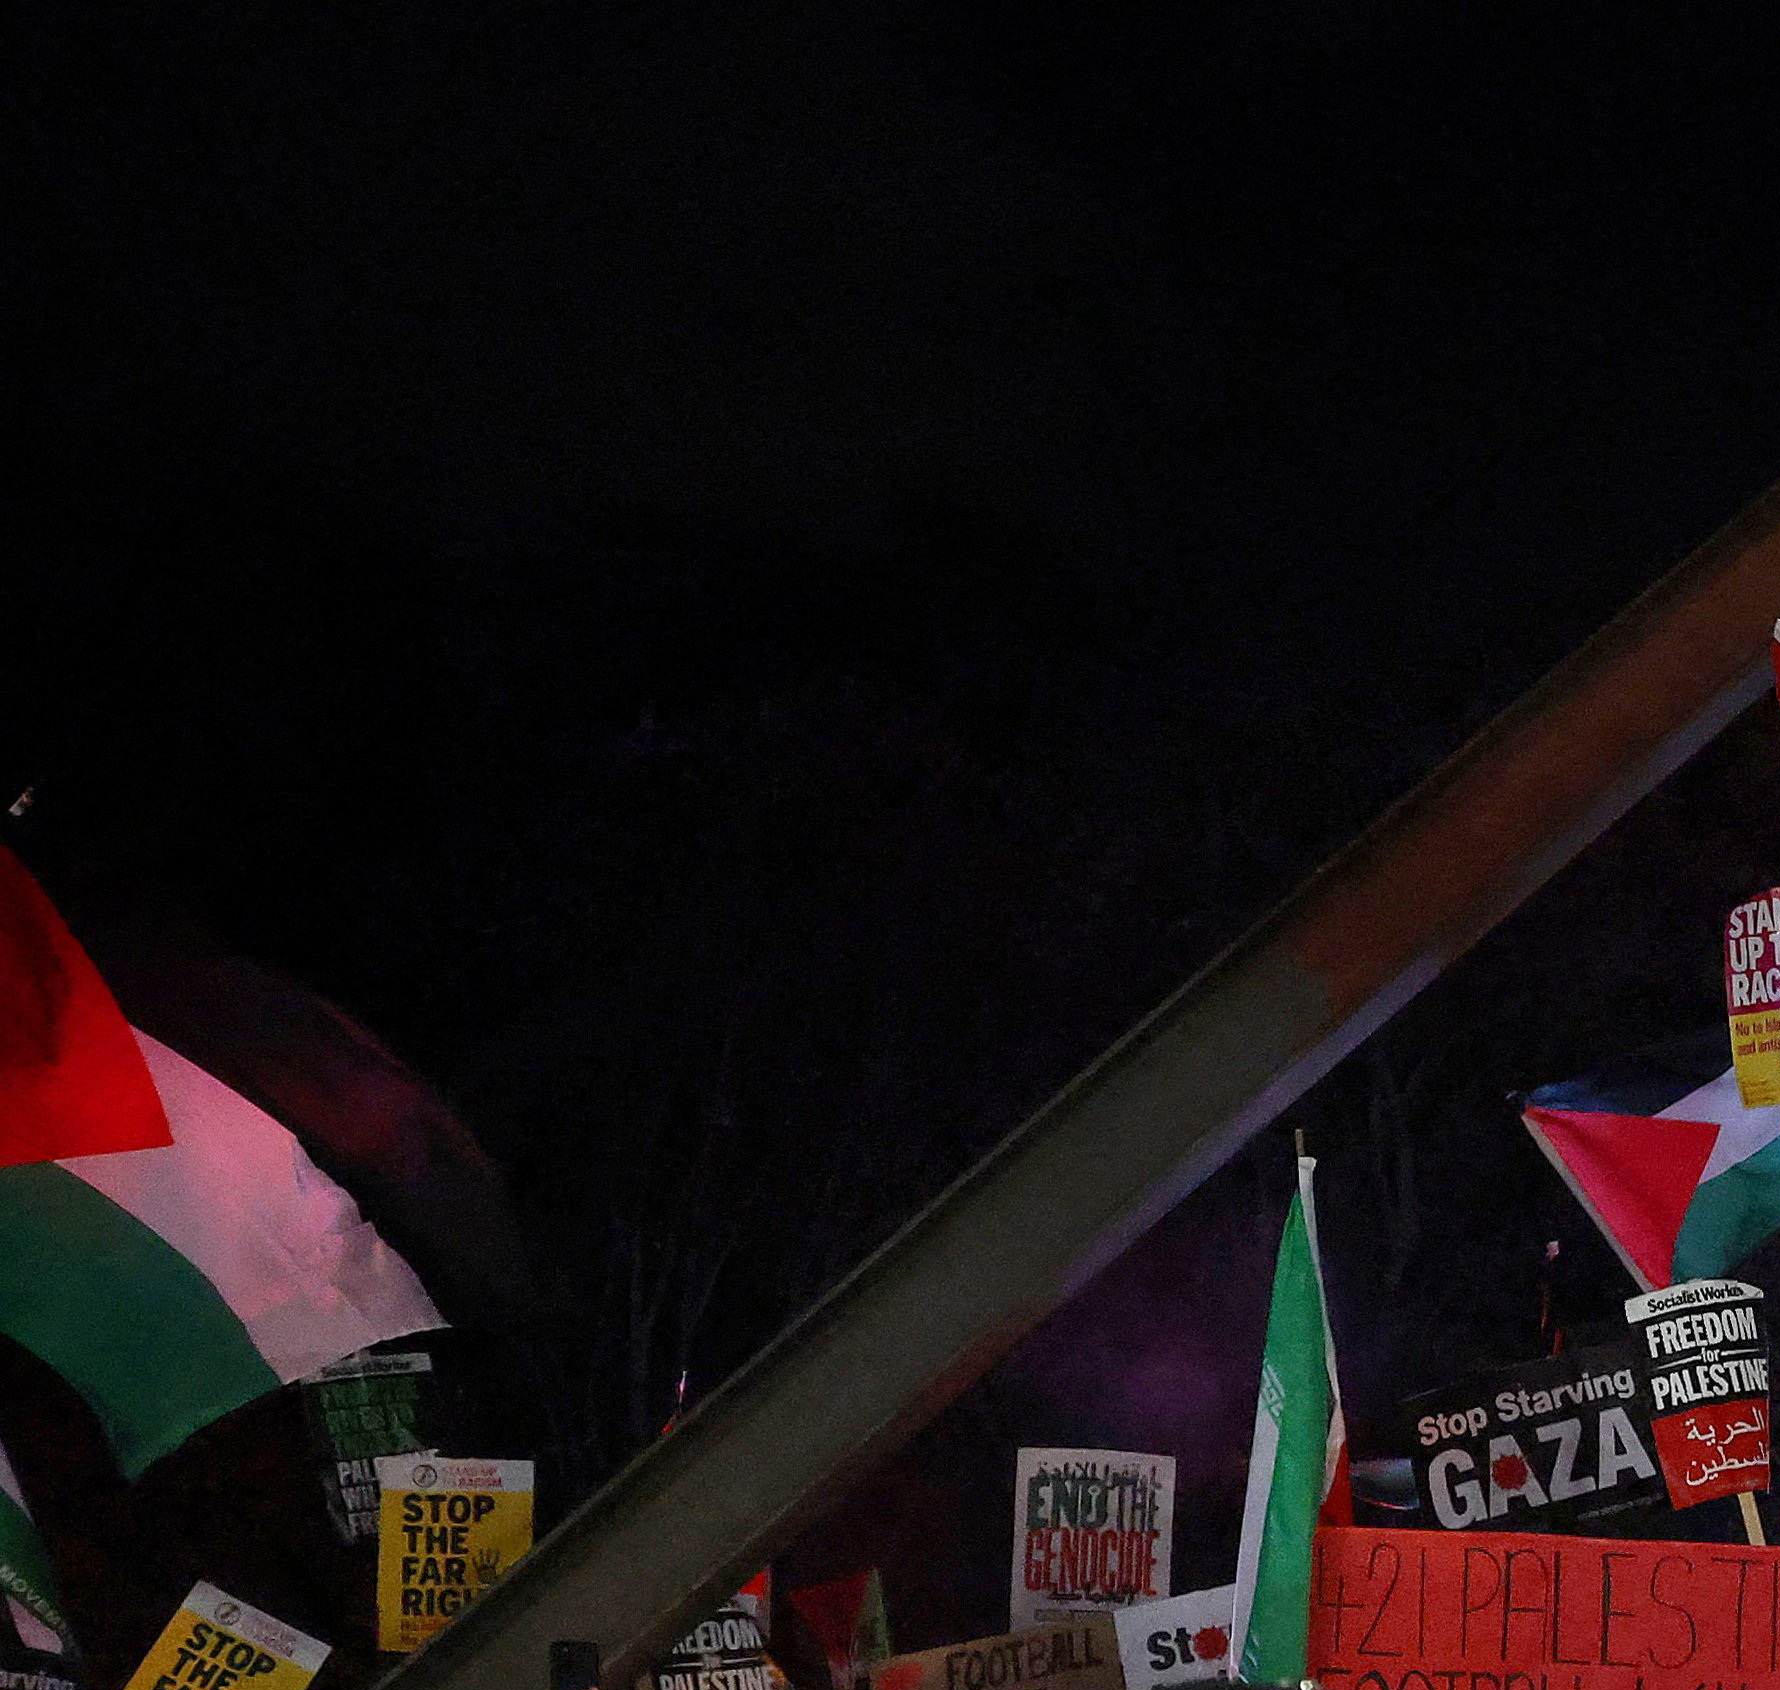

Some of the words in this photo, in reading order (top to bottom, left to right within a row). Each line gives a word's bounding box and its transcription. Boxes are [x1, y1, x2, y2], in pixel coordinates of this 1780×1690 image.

[1729, 936, 1765, 973] UP
[1647, 1287, 1702, 1313] Socialist
[1645, 1306, 1758, 1359] FREEDOM
[1701, 1347, 1720, 1363] for
[1417, 1406, 1488, 1446] Stop
[1495, 1368, 1635, 1423] Starving
[1651, 1358, 1769, 1411] PALESTINE
[1427, 1405, 1657, 1530] GAZA
[401, 1493, 496, 1524] STOP
[1026, 1475, 1104, 1529] END
[401, 1525, 470, 1555] THE
[1023, 1526, 1161, 1597] GENOCIDE
[400, 1557, 467, 1586] FAR
[400, 1588, 471, 1618] RIG
[186, 1623, 277, 1678] STOP
